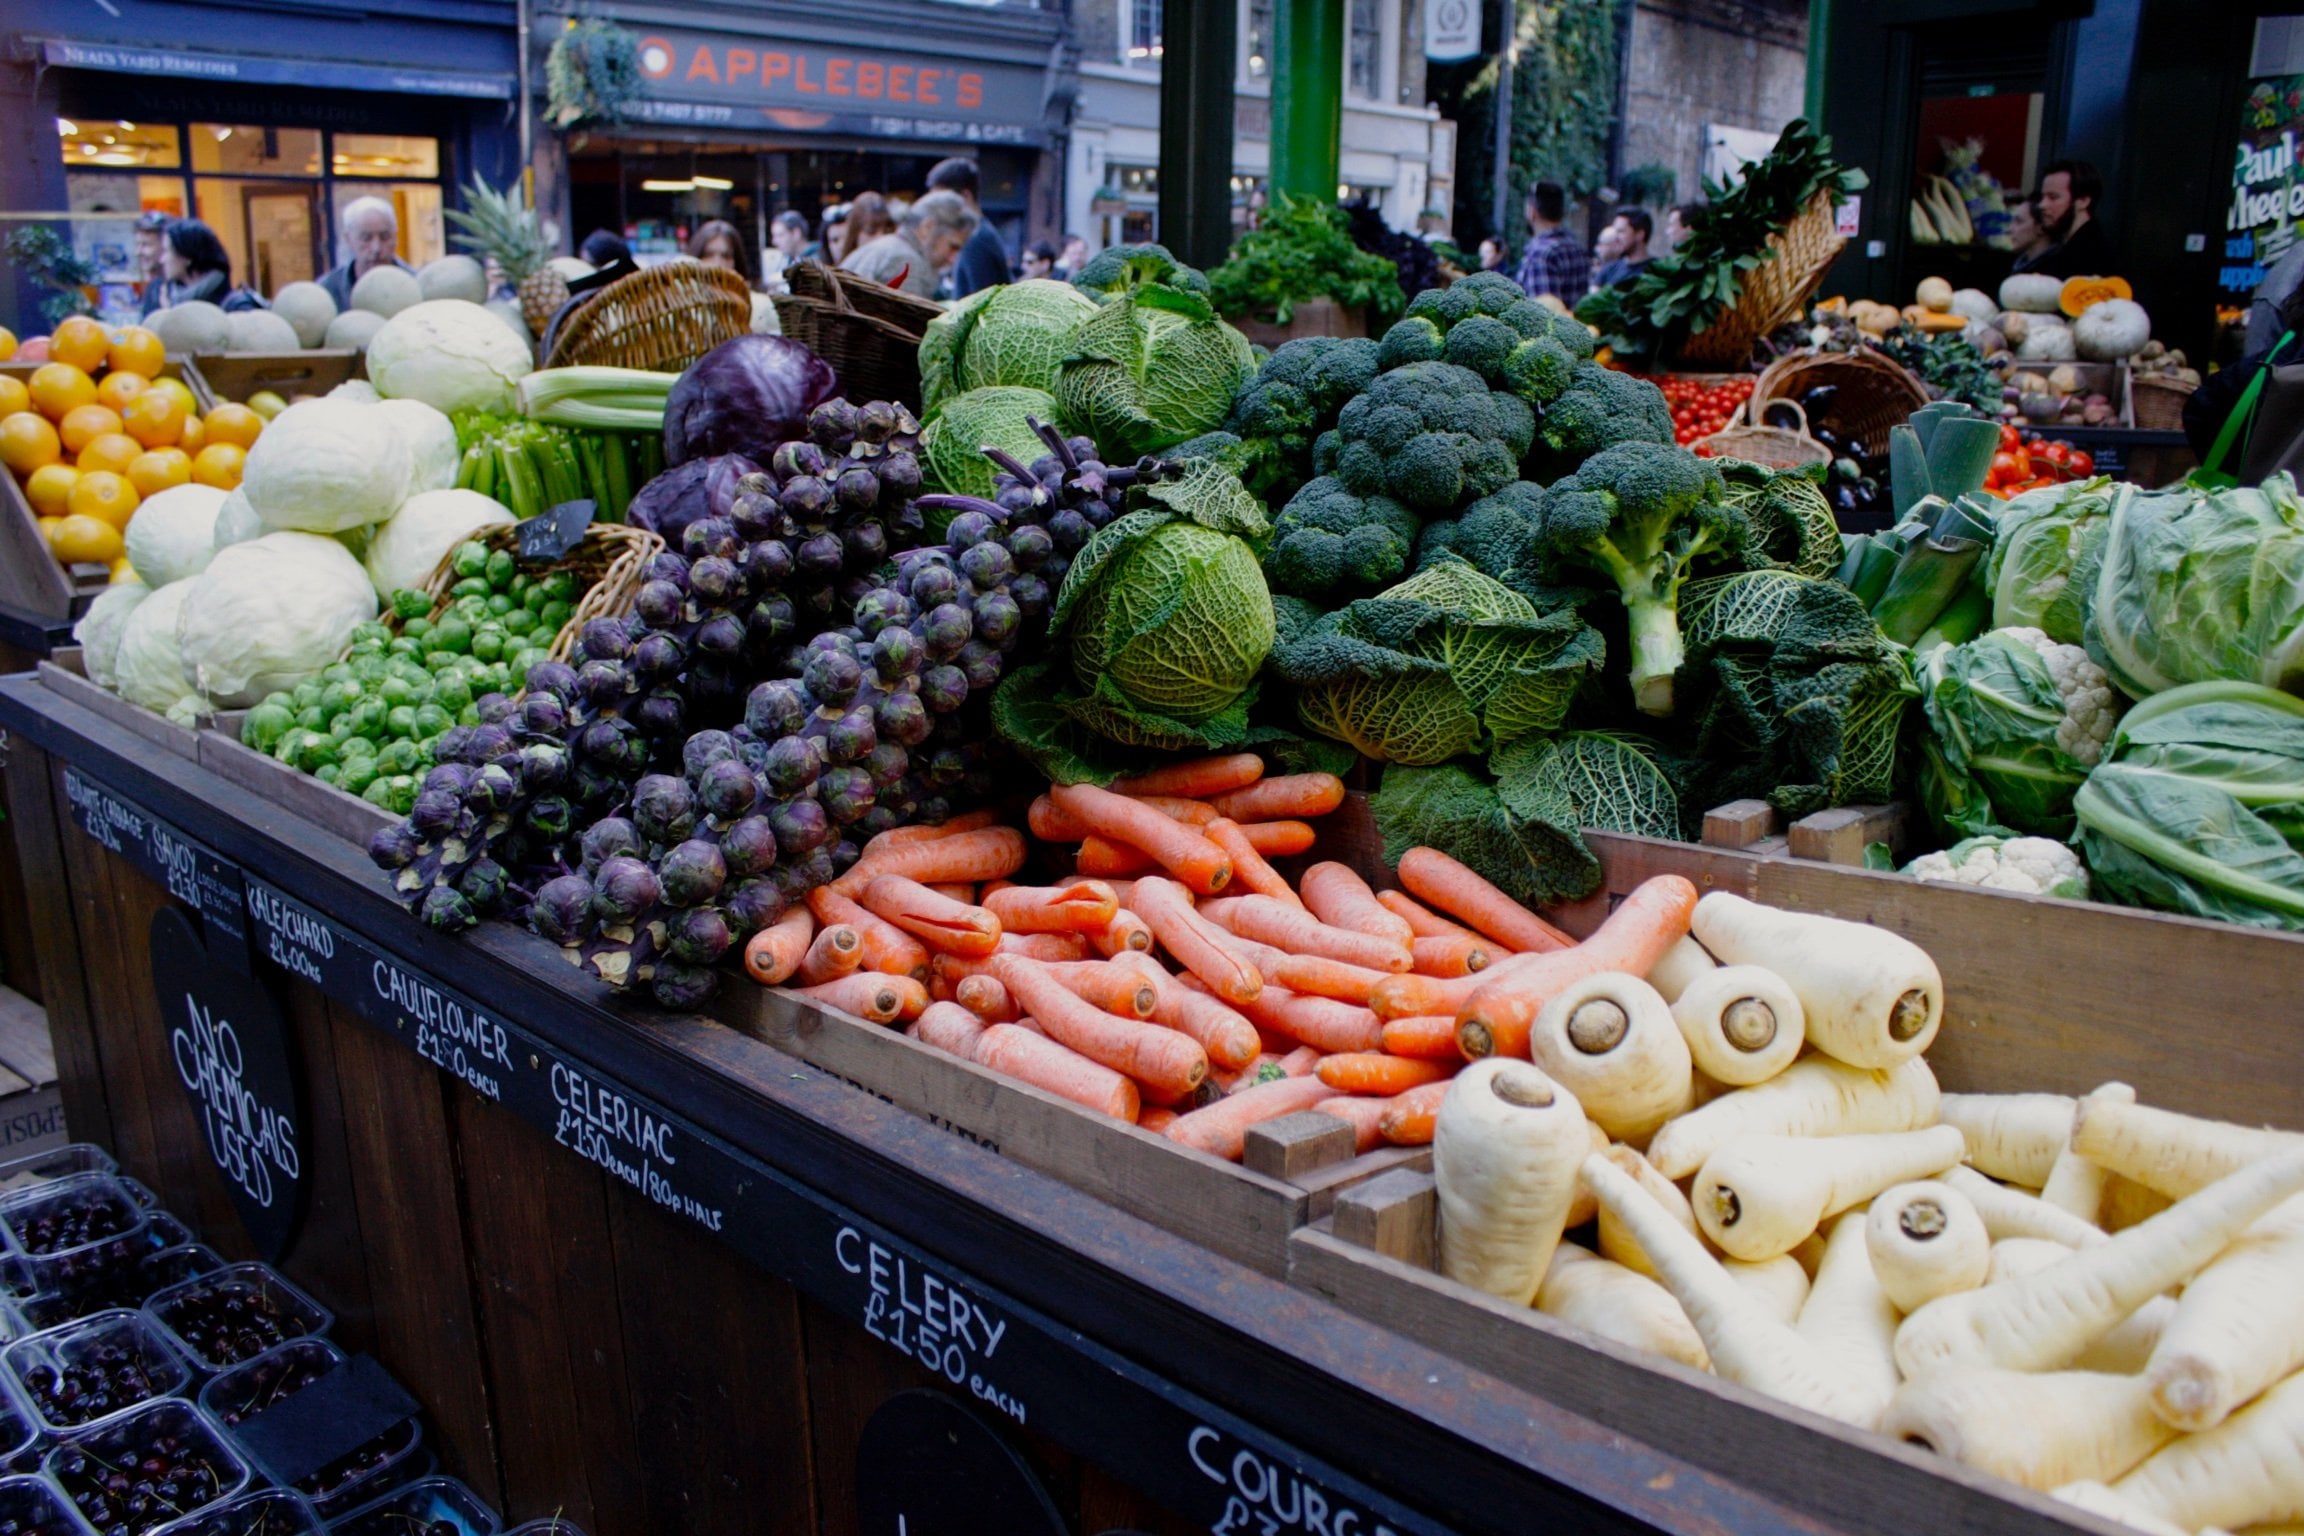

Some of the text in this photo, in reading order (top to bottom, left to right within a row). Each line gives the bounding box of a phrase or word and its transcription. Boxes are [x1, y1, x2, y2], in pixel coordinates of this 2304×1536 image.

[119, 51, 161, 71] YARD
[686, 45, 983, 108] APPLEBEE'S
[153, 824, 196, 881] SAVOY
[245, 881, 334, 959] KALE/CHARD
[186, 992, 243, 1078] NO
[373, 959, 513, 1071] CAULIFLOWER
[173, 1028, 299, 1180] CHEMICALS
[551, 1062, 676, 1165] CELERIAC
[205, 1103, 273, 1208] USED
[836, 1226, 1006, 1358] CELERY
[864, 1291, 966, 1384] £1.50
